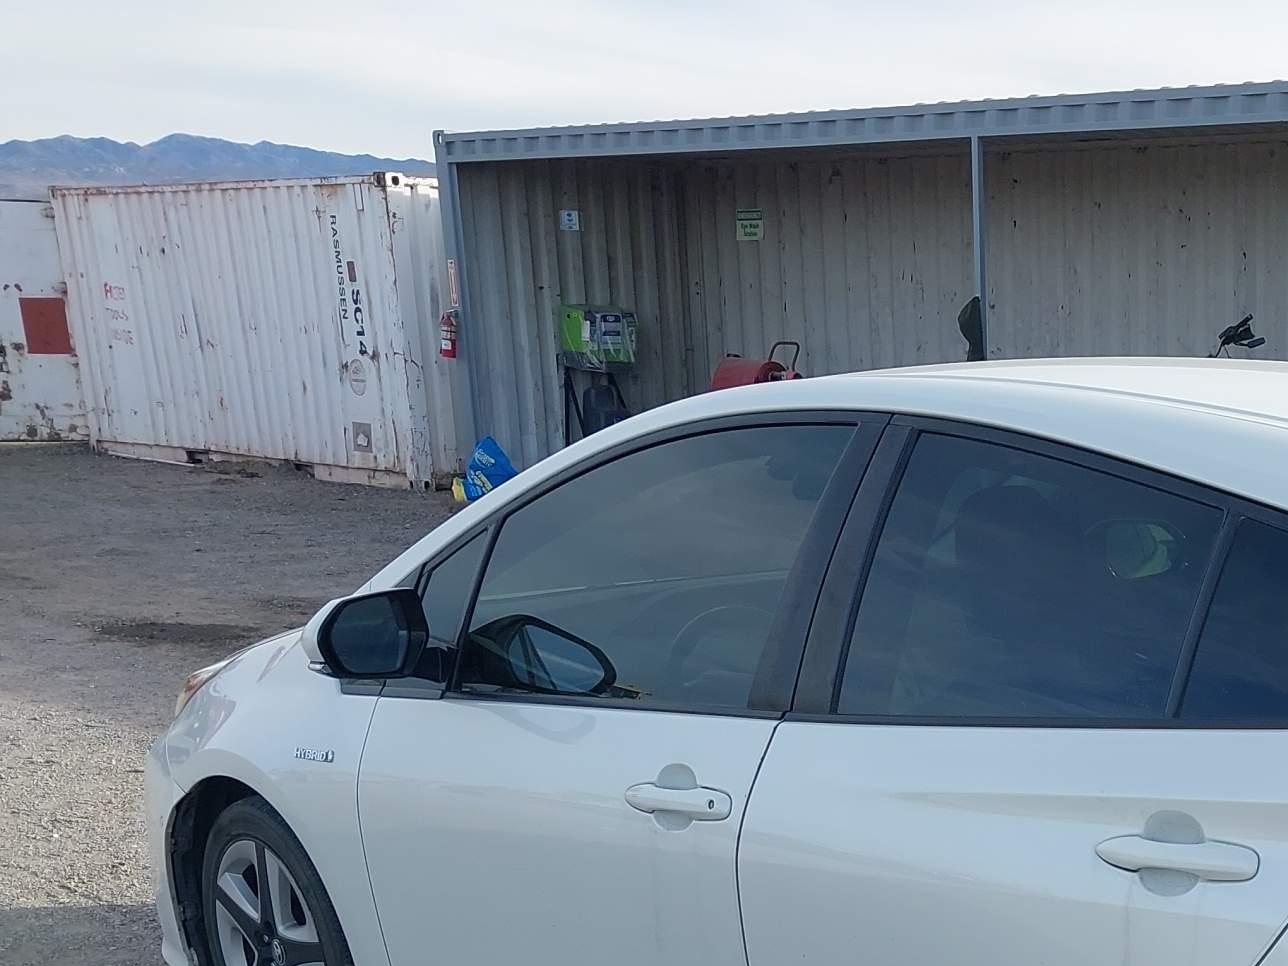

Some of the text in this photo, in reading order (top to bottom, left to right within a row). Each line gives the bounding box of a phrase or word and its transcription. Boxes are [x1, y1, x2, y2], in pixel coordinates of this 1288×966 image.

[329, 214, 349, 321] RASMUSSEN
[351, 288, 367, 357] SC14
[294, 747, 327, 763] HYBRID
